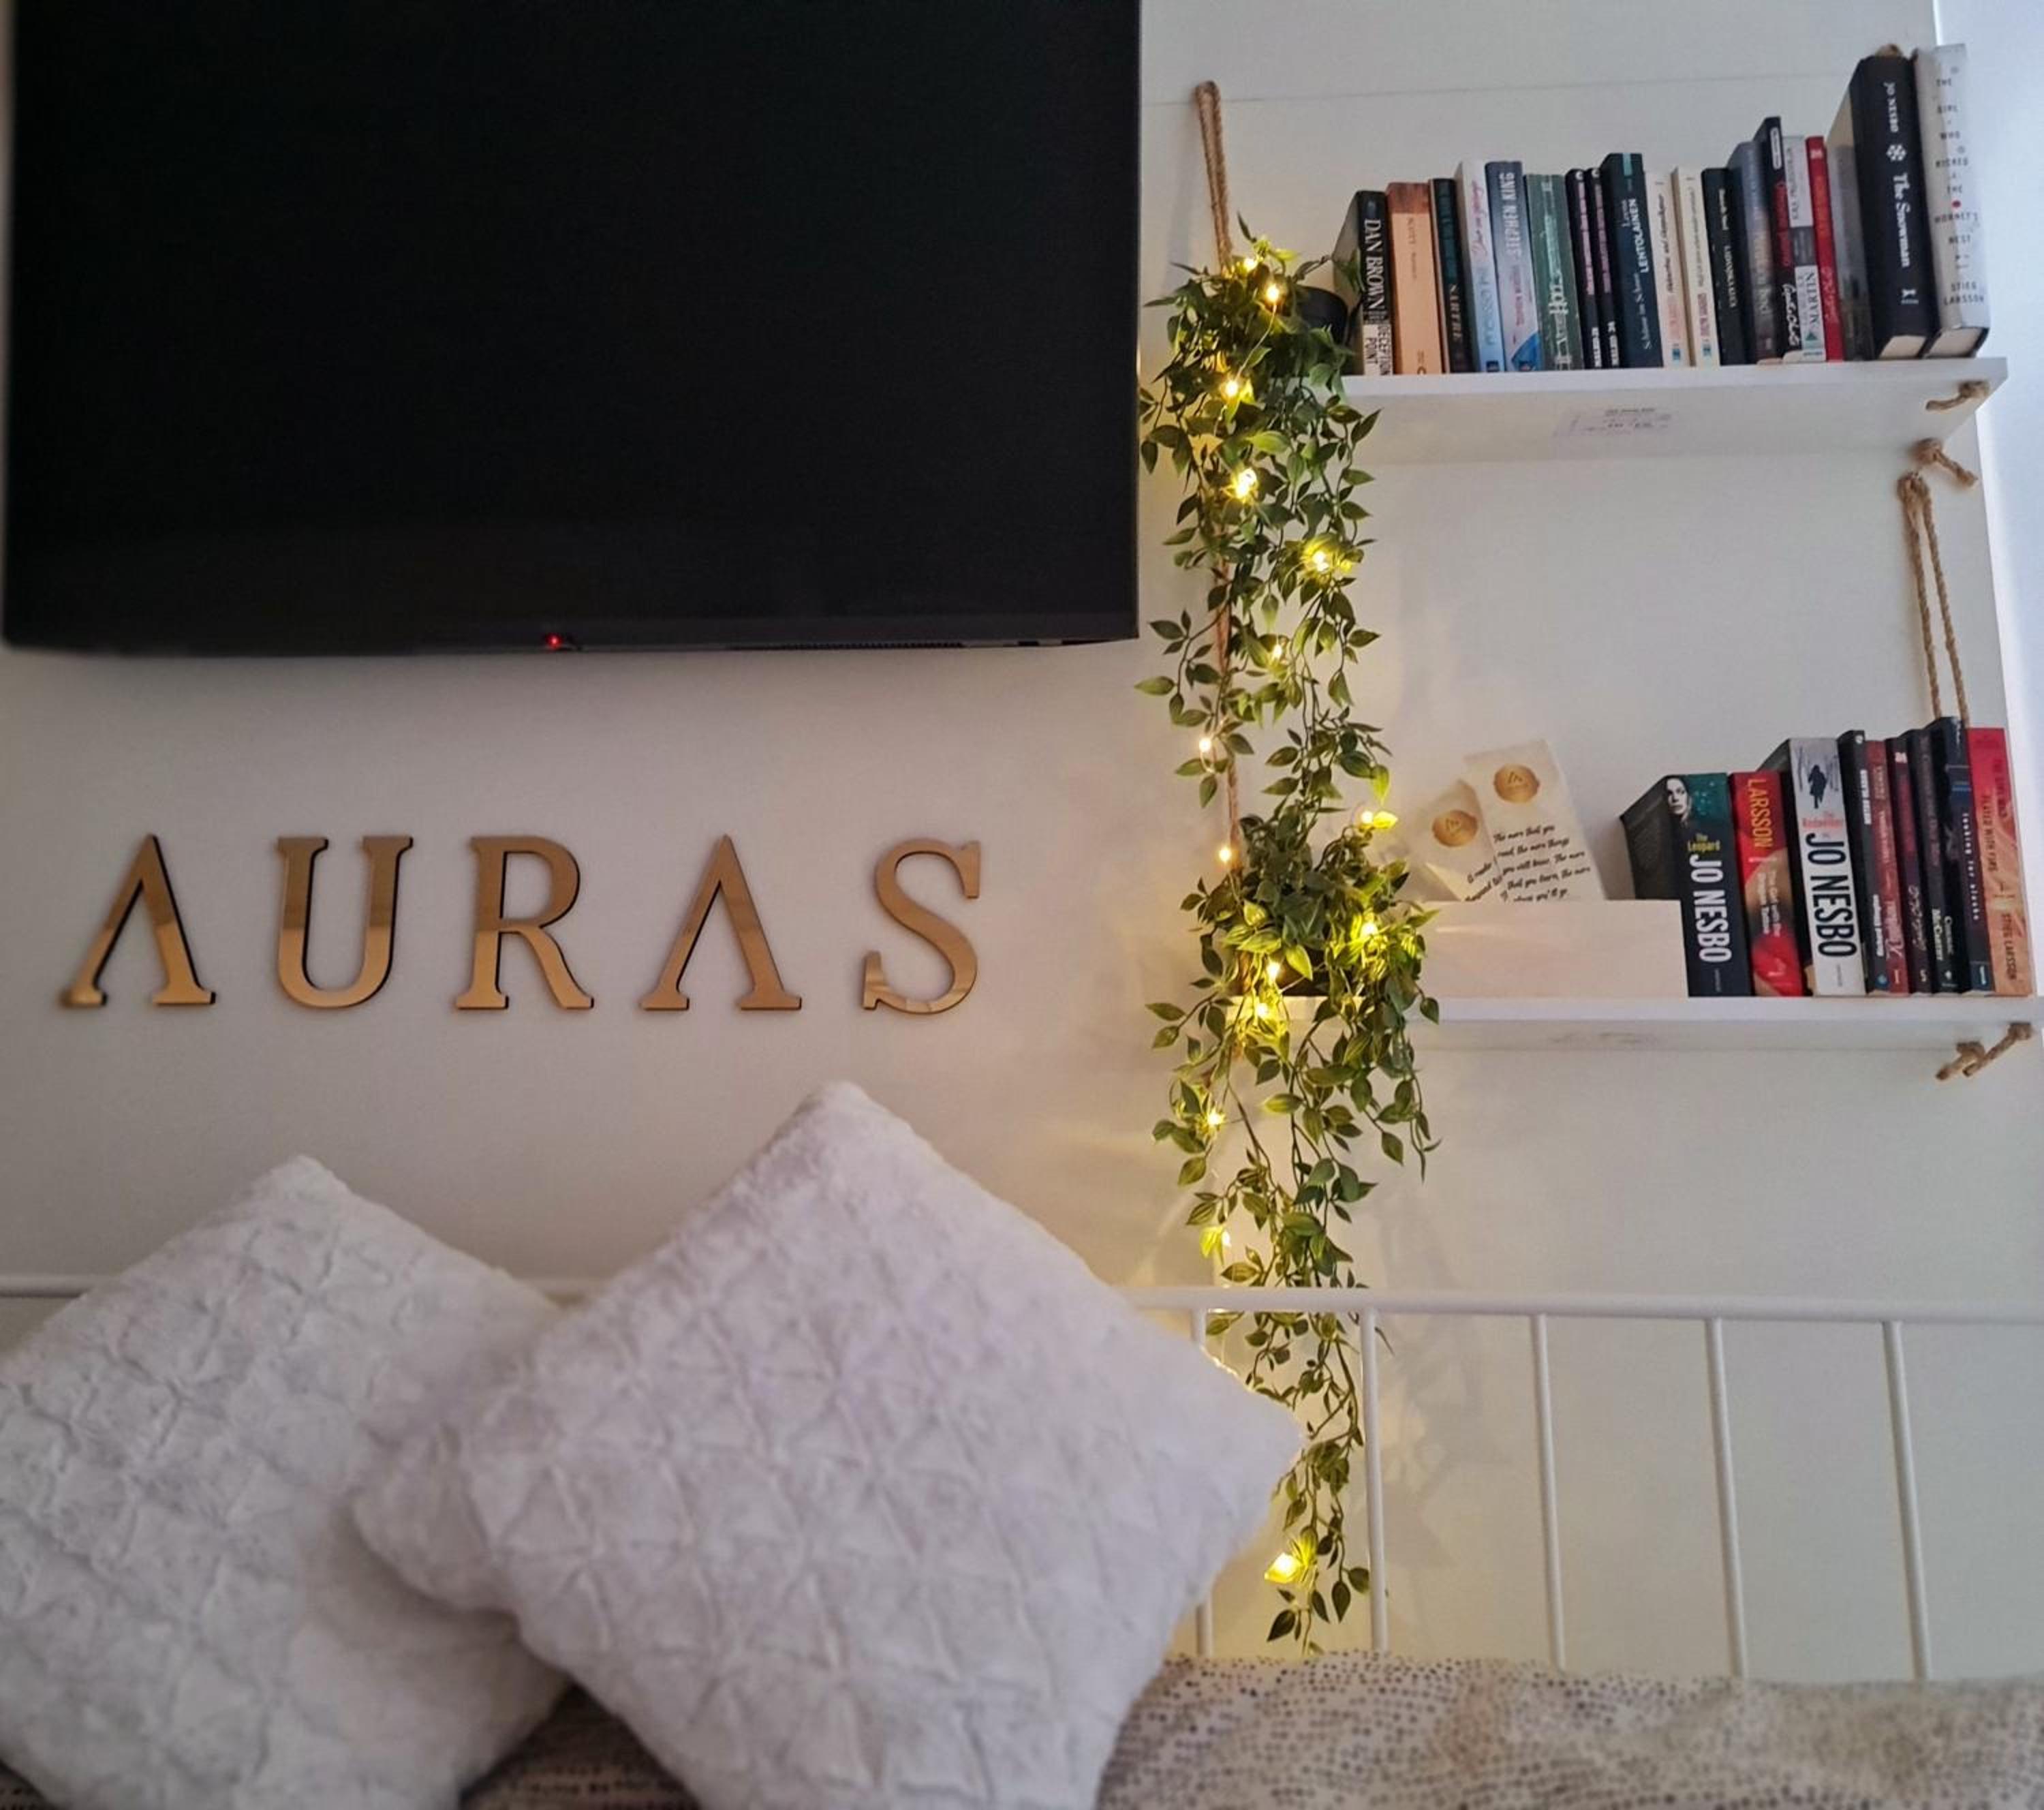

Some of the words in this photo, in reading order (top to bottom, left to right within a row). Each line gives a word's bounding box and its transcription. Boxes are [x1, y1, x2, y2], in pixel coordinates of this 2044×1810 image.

[1884, 82, 1895, 95] JO
[1888, 98, 1899, 133] NESBO
[1500, 172, 1517, 200] KING
[1893, 172, 1910, 200] The
[1364, 218, 1383, 253] DAN
[1502, 206, 1523, 260] STEPHEN
[1896, 202, 1910, 268] Snowman
[1365, 256, 1385, 310] BROWN
[1951, 281, 1977, 293] STIEG
[1806, 272, 1818, 325] MARTIN
[1944, 293, 1985, 307] LARSSON
[1365, 337, 1378, 365] POINT
[1748, 778, 1774, 848] LARSSON
[1981, 795, 1992, 826] PLAYED
[1493, 832, 1506, 843] The
[1508, 831, 1523, 839] more
[1526, 825, 1541, 837] that
[1543, 825, 1555, 835] you
[1688, 840, 1720, 853] Leopard
[1806, 832, 1846, 865] JO
[1983, 829, 1994, 850] WITH
[1502, 867, 1515, 876] you
[1517, 860, 1531, 871] will
[1569, 850, 1585, 859] more
[1517, 845, 1528, 855] the
[1530, 843, 1546, 851] more
[1987, 853, 1998, 873] FIRE
[1525, 878, 1537, 889] you
[1561, 868, 1573, 880] the
[1575, 866, 1591, 875] more
[1689, 854, 1724, 883] JO
[1962, 813, 1972, 855] looking
[1970, 884, 1980, 920] alaska
[58, 833, 981, 1015] AURAS
[1692, 889, 1732, 963] NESBO
[1810, 875, 1857, 957] NESBO
[2002, 912, 2012, 938] STIEG
[2004, 940, 2017, 981] LARSSON
